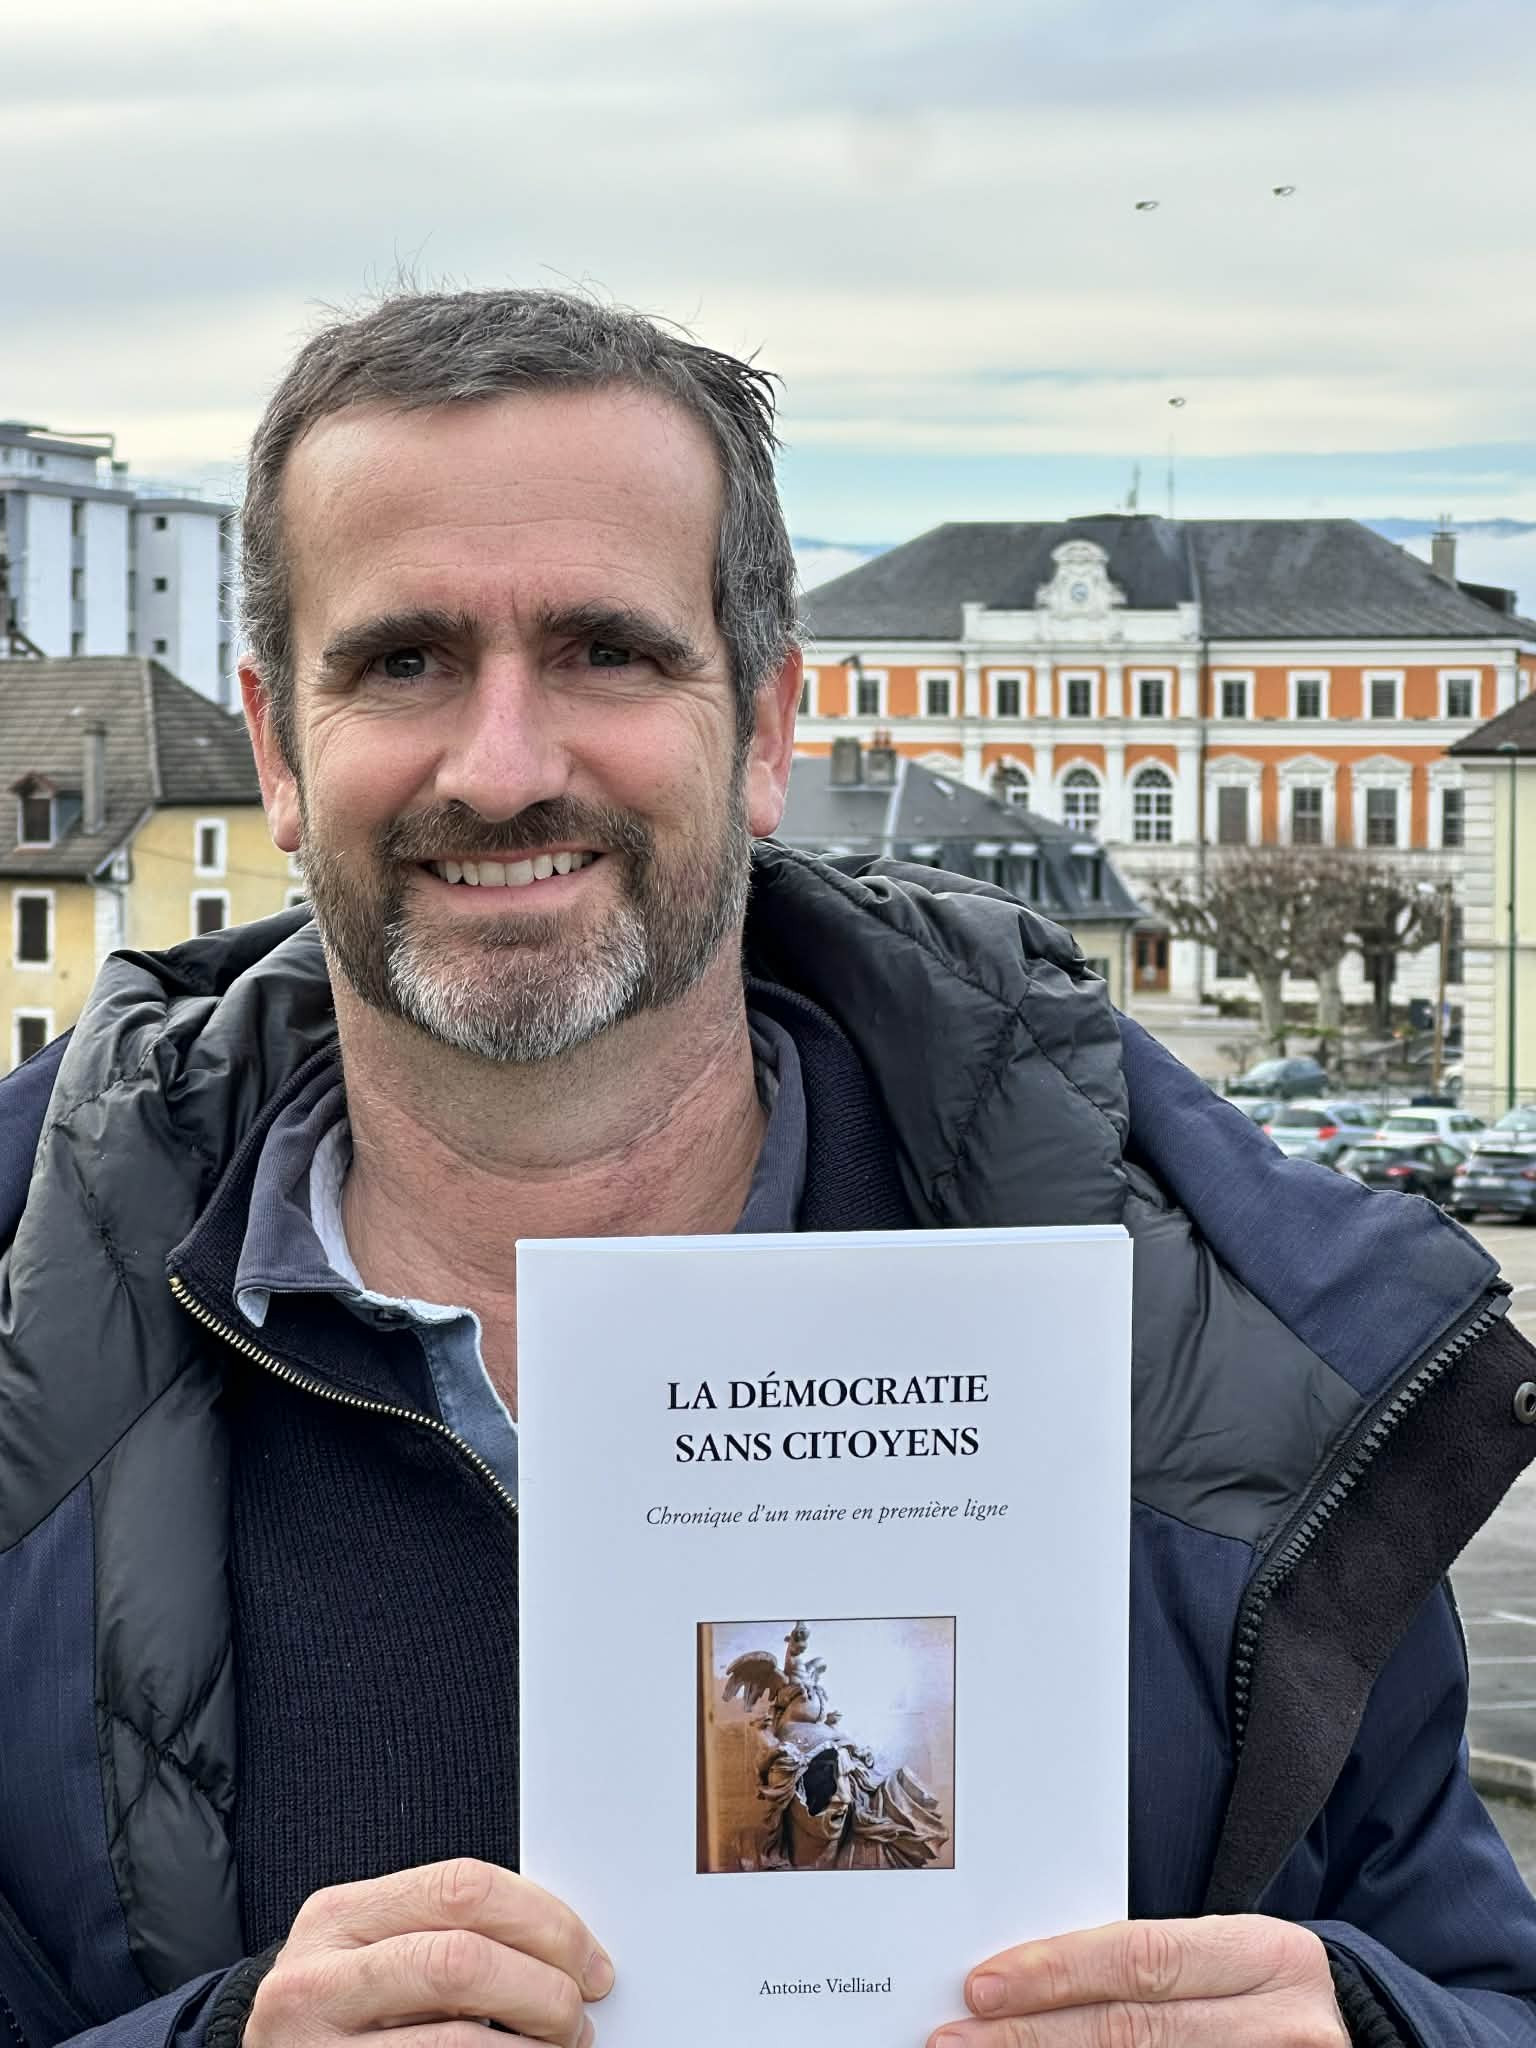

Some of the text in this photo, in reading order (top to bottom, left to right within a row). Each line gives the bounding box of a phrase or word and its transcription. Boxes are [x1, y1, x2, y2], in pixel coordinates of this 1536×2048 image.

[667, 1371, 989, 1410] LA DÉMOCRATIE
[676, 1427, 979, 1463] SANS CITOYENS
[647, 1498, 1008, 1528] Chronique d'un maire en première ligne
[760, 1977, 891, 1995] Antoine Vielliard
